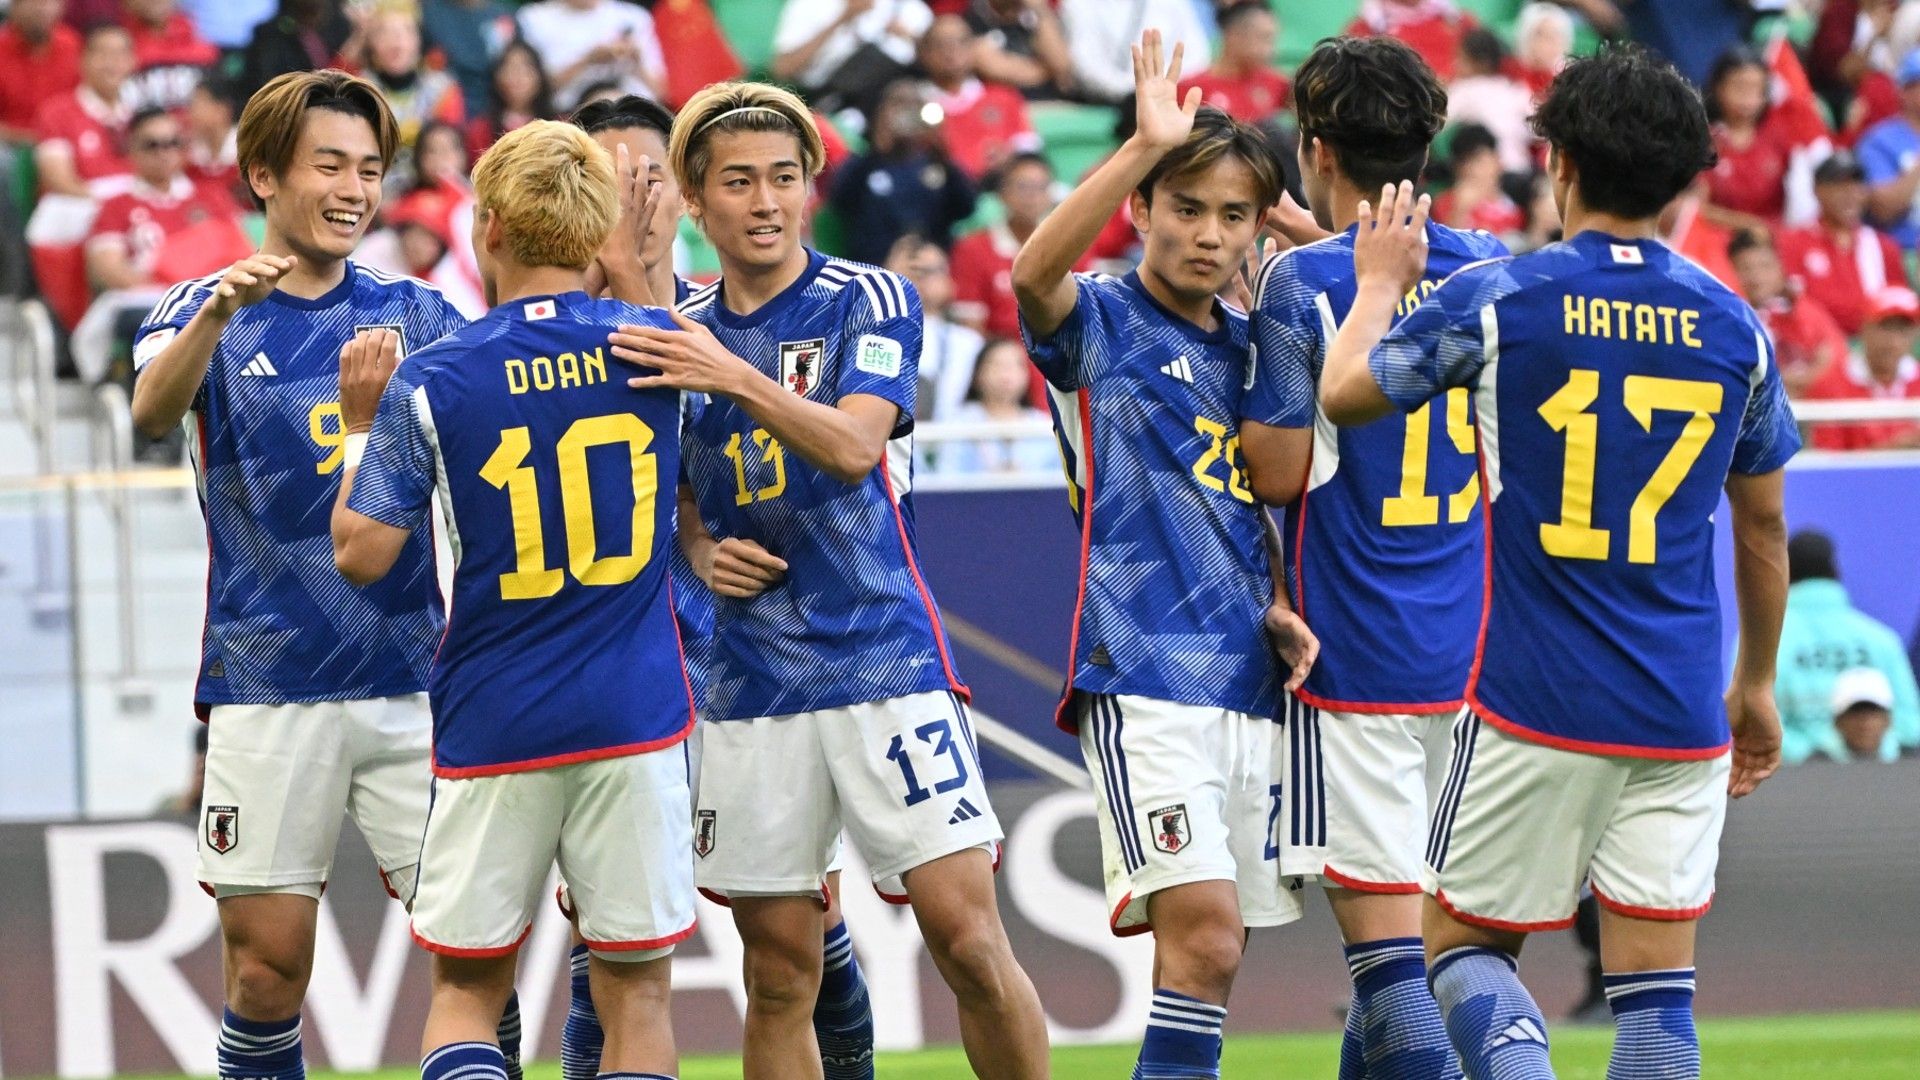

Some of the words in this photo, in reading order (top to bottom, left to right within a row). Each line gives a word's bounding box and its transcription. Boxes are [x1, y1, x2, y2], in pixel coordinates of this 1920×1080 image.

[791, 342, 815, 350] JAPAN
[866, 341, 884, 350] AFC
[1563, 294, 1703, 348] HATATE
[504, 346, 608, 395] DOAN
[864, 347, 895, 361] LIVE
[308, 402, 348, 475] 9
[723, 428, 787, 507] 13
[1536, 368, 1724, 564] 17
[478, 412, 658, 600] 10
[886, 718, 969, 808] 13
